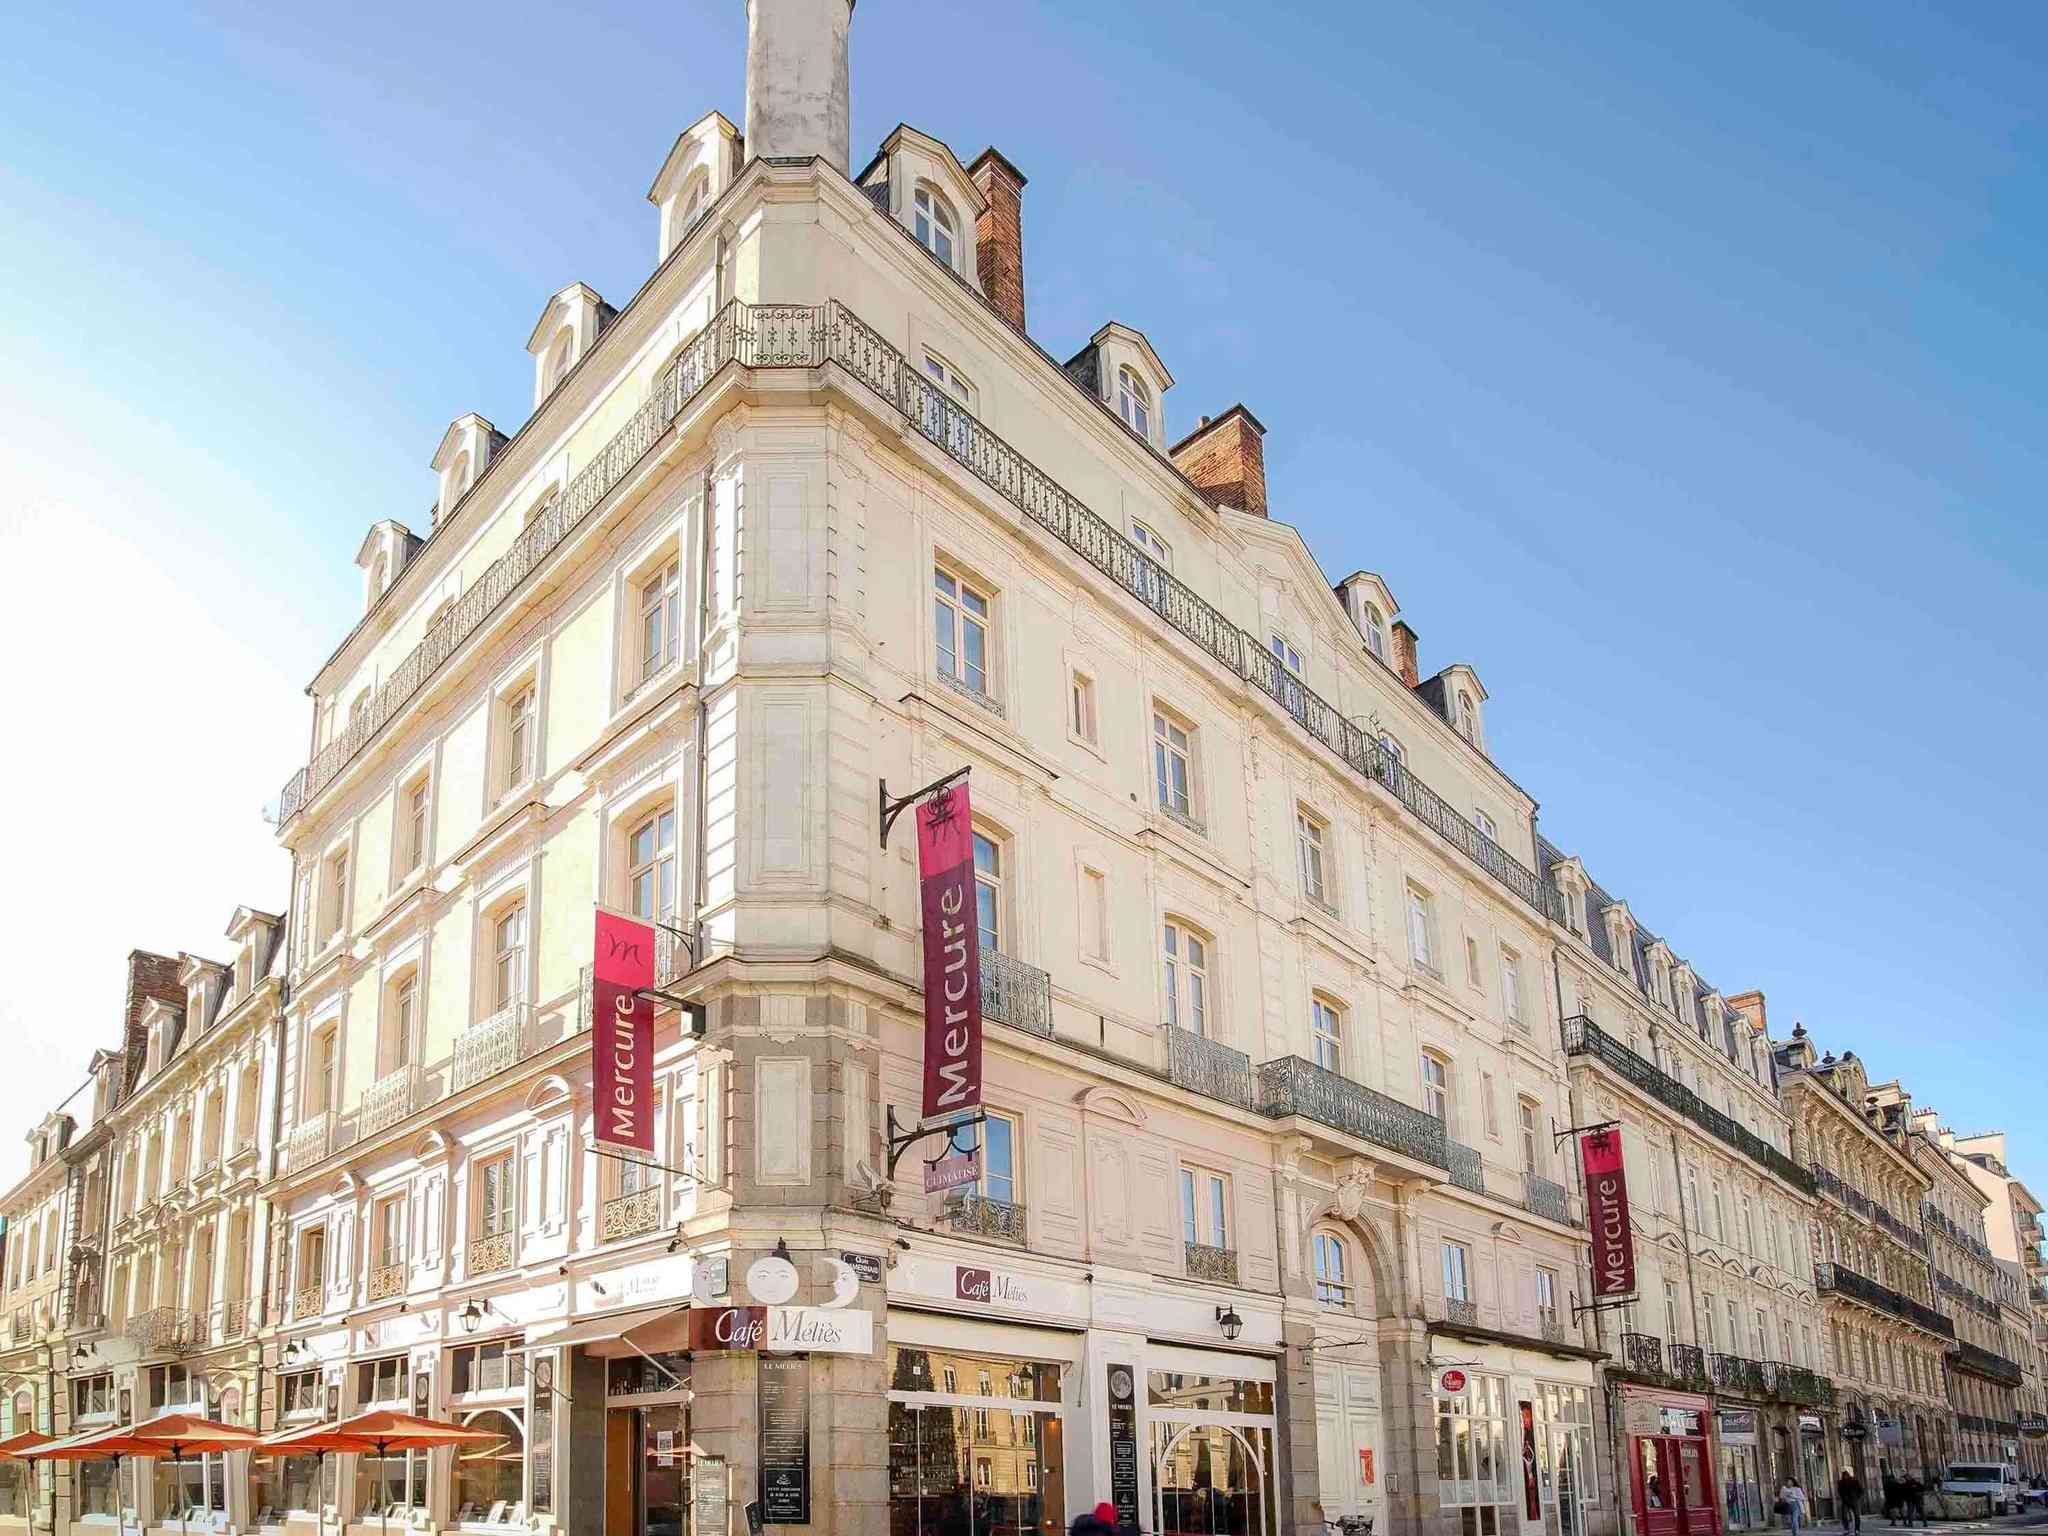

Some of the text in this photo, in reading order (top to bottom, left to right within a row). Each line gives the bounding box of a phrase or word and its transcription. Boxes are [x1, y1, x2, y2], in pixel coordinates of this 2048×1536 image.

[936, 884, 970, 1107] Mercure
[612, 993, 635, 1138] Mercure
[960, 1270, 989, 1300] Café
[1599, 1178, 1626, 1292] Mercure
[715, 1308, 843, 1348] Café Méliès
